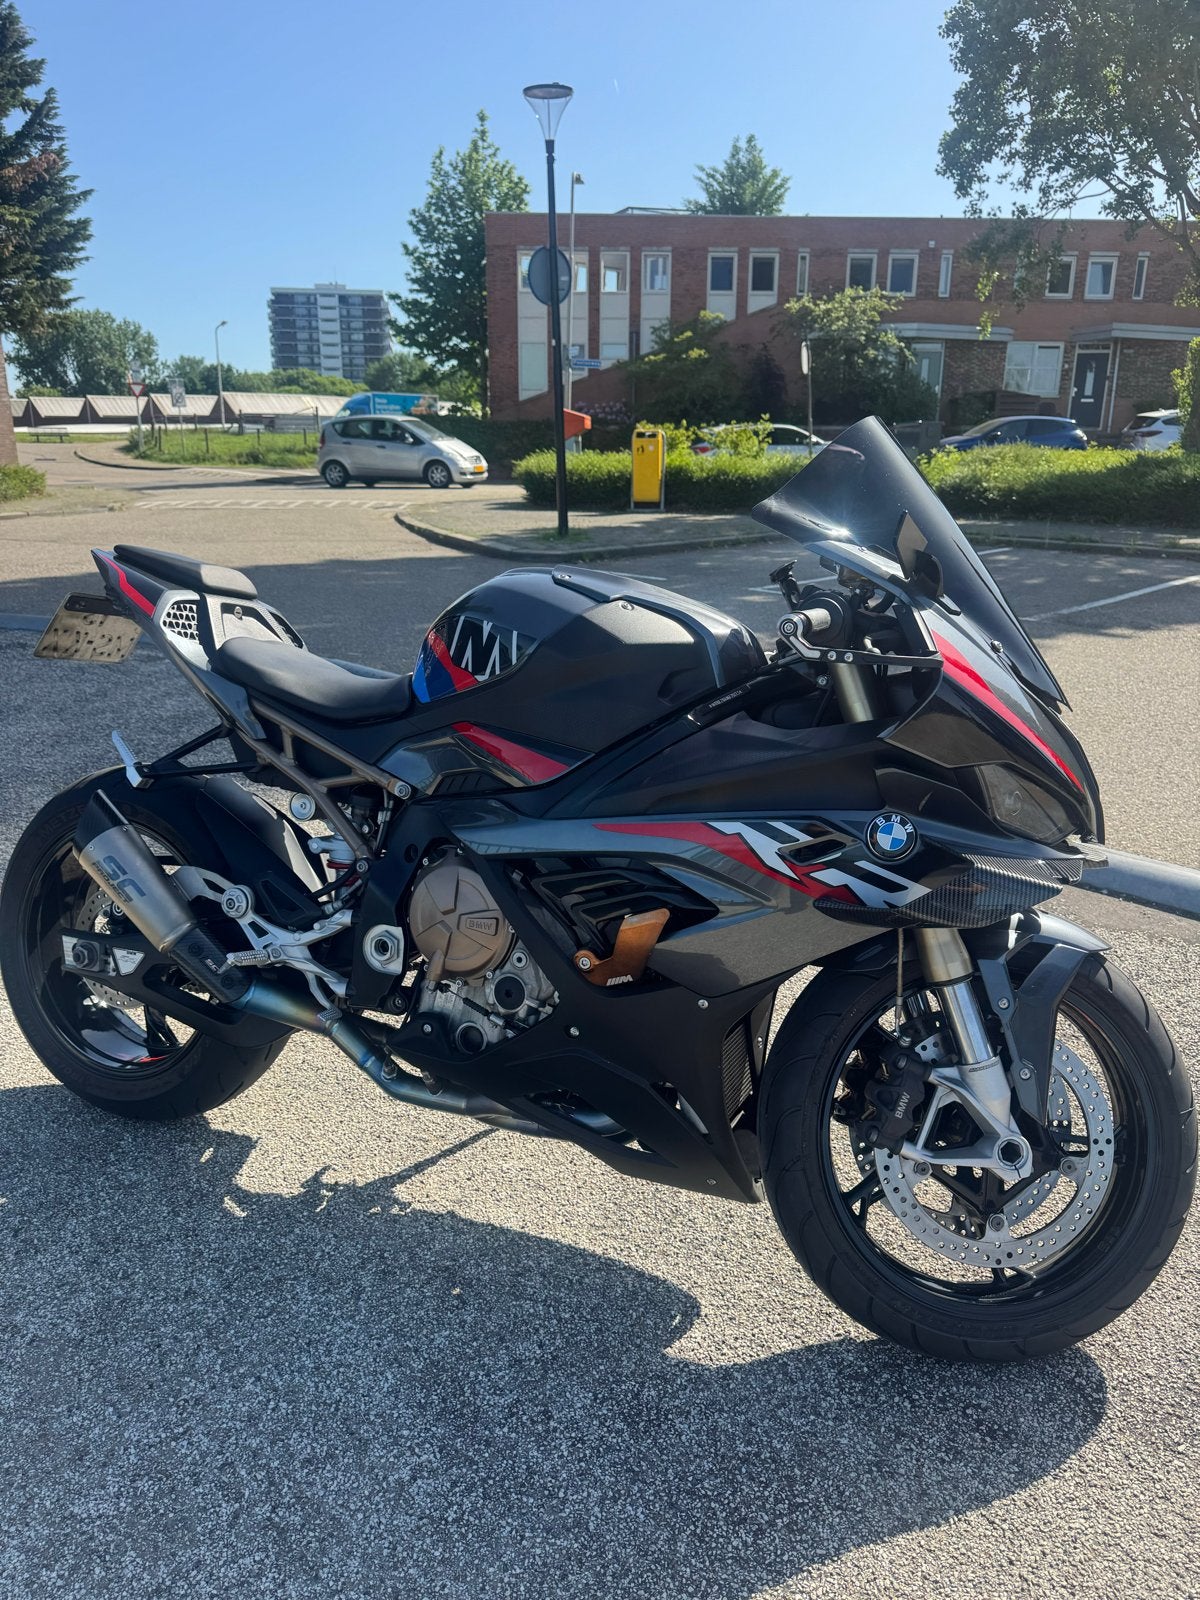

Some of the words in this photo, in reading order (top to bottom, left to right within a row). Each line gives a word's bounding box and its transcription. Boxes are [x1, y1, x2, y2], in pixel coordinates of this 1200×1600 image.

[875, 814, 915, 833] BMW
[469, 919, 494, 931] BMW
[894, 1091, 910, 1119] BMW
